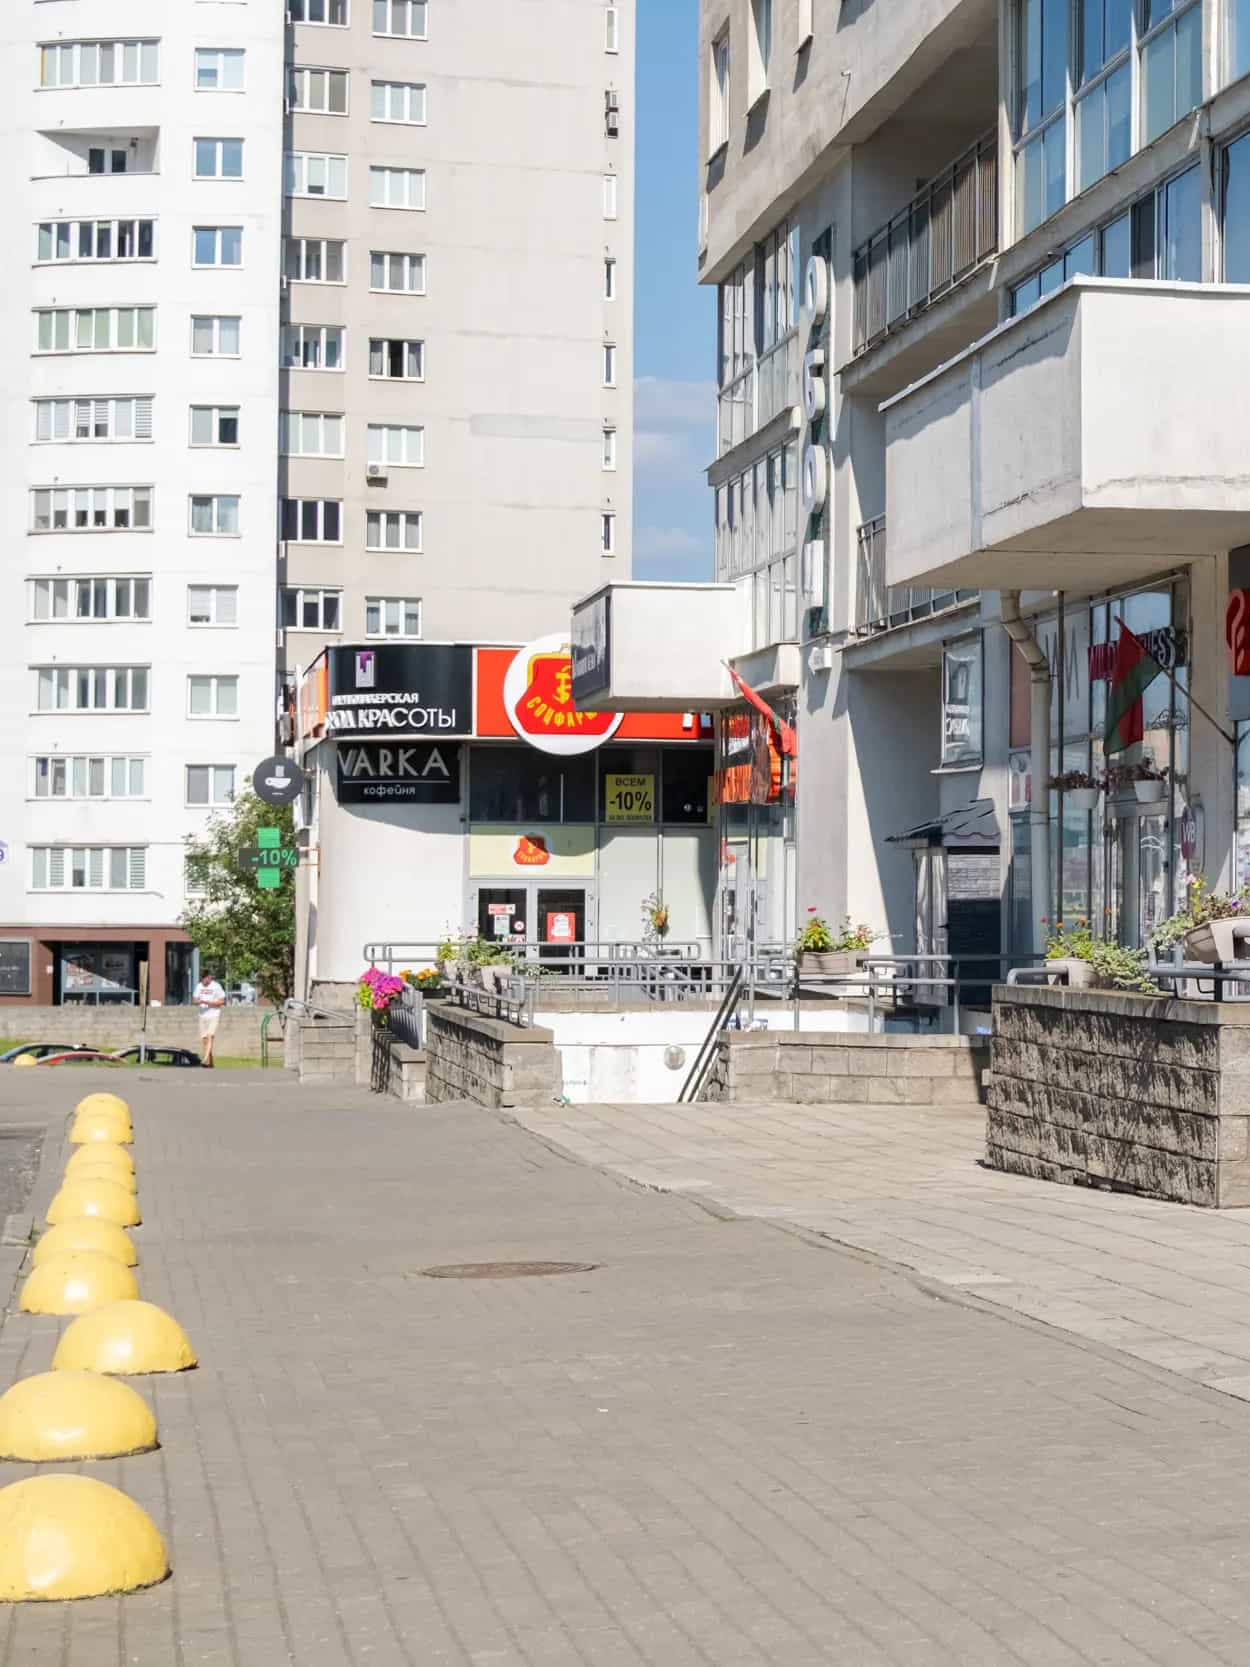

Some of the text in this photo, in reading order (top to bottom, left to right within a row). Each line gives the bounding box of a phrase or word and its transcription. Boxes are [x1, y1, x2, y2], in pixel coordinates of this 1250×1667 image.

[358, 707, 456, 729] КРАСОТЫ
[337, 747, 450, 777] VARKA
[364, 784, 416, 797] кофейня
[609, 791, 651, 812] -10%
[252, 849, 297, 866] -10%
